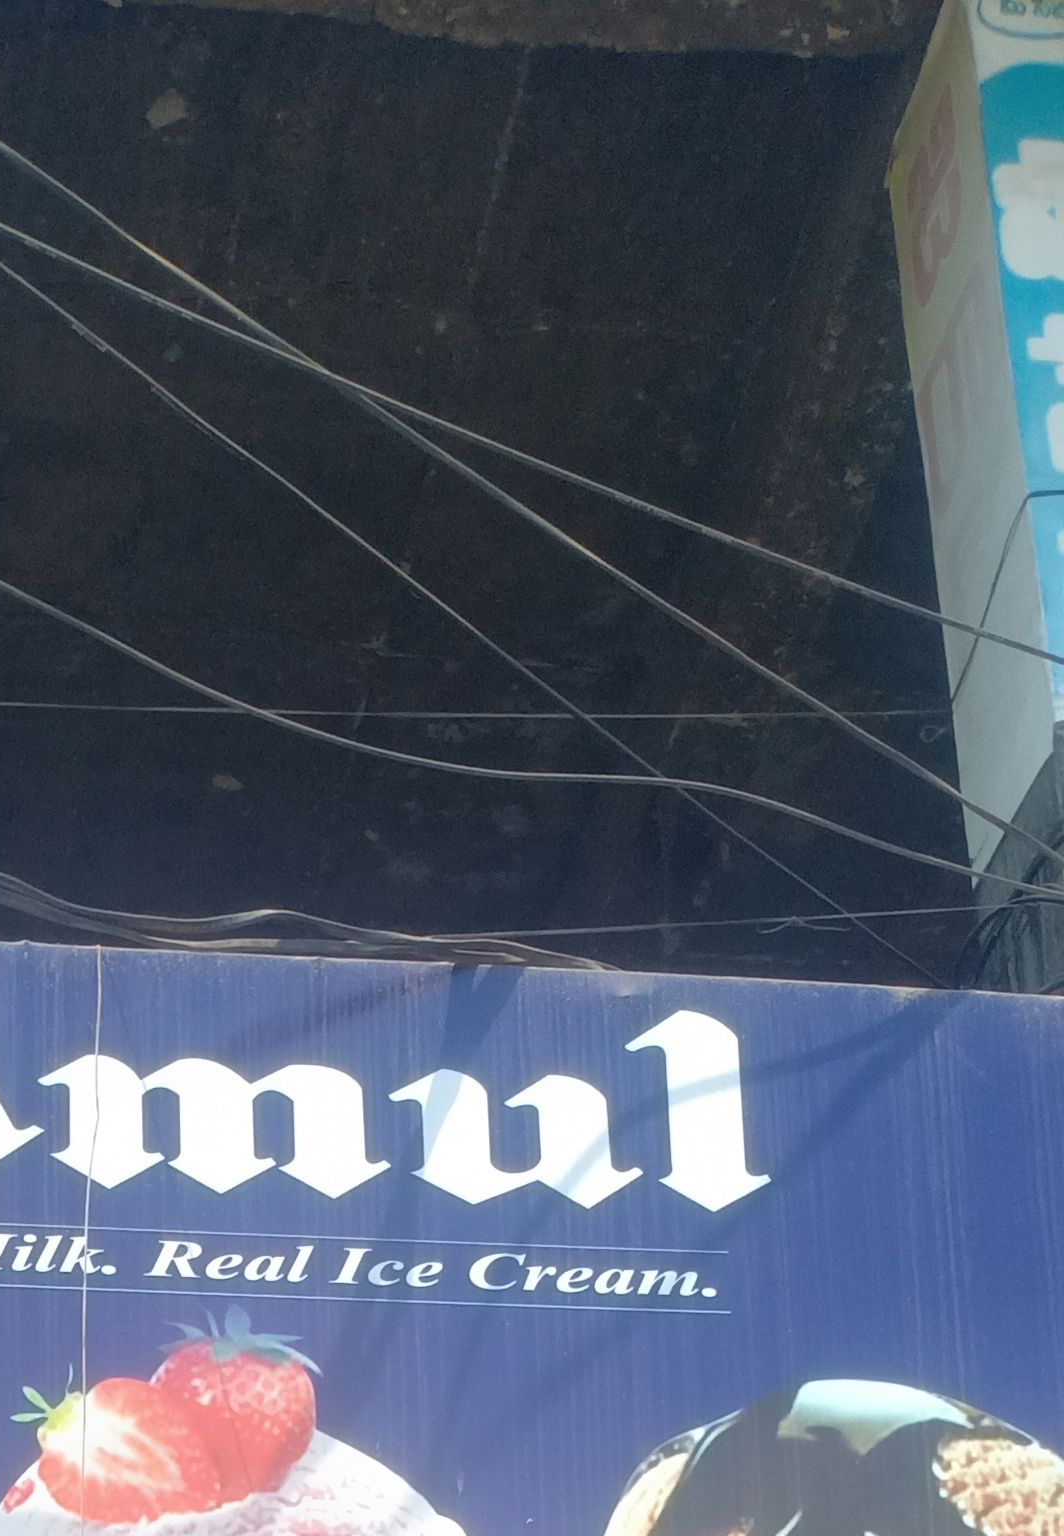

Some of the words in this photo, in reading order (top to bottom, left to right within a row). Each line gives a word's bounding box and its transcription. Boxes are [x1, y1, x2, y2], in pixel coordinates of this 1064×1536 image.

[143, 1240, 314, 1283] Real
[330, 1247, 443, 1288] Ice
[469, 1253, 717, 1298] Cream.
